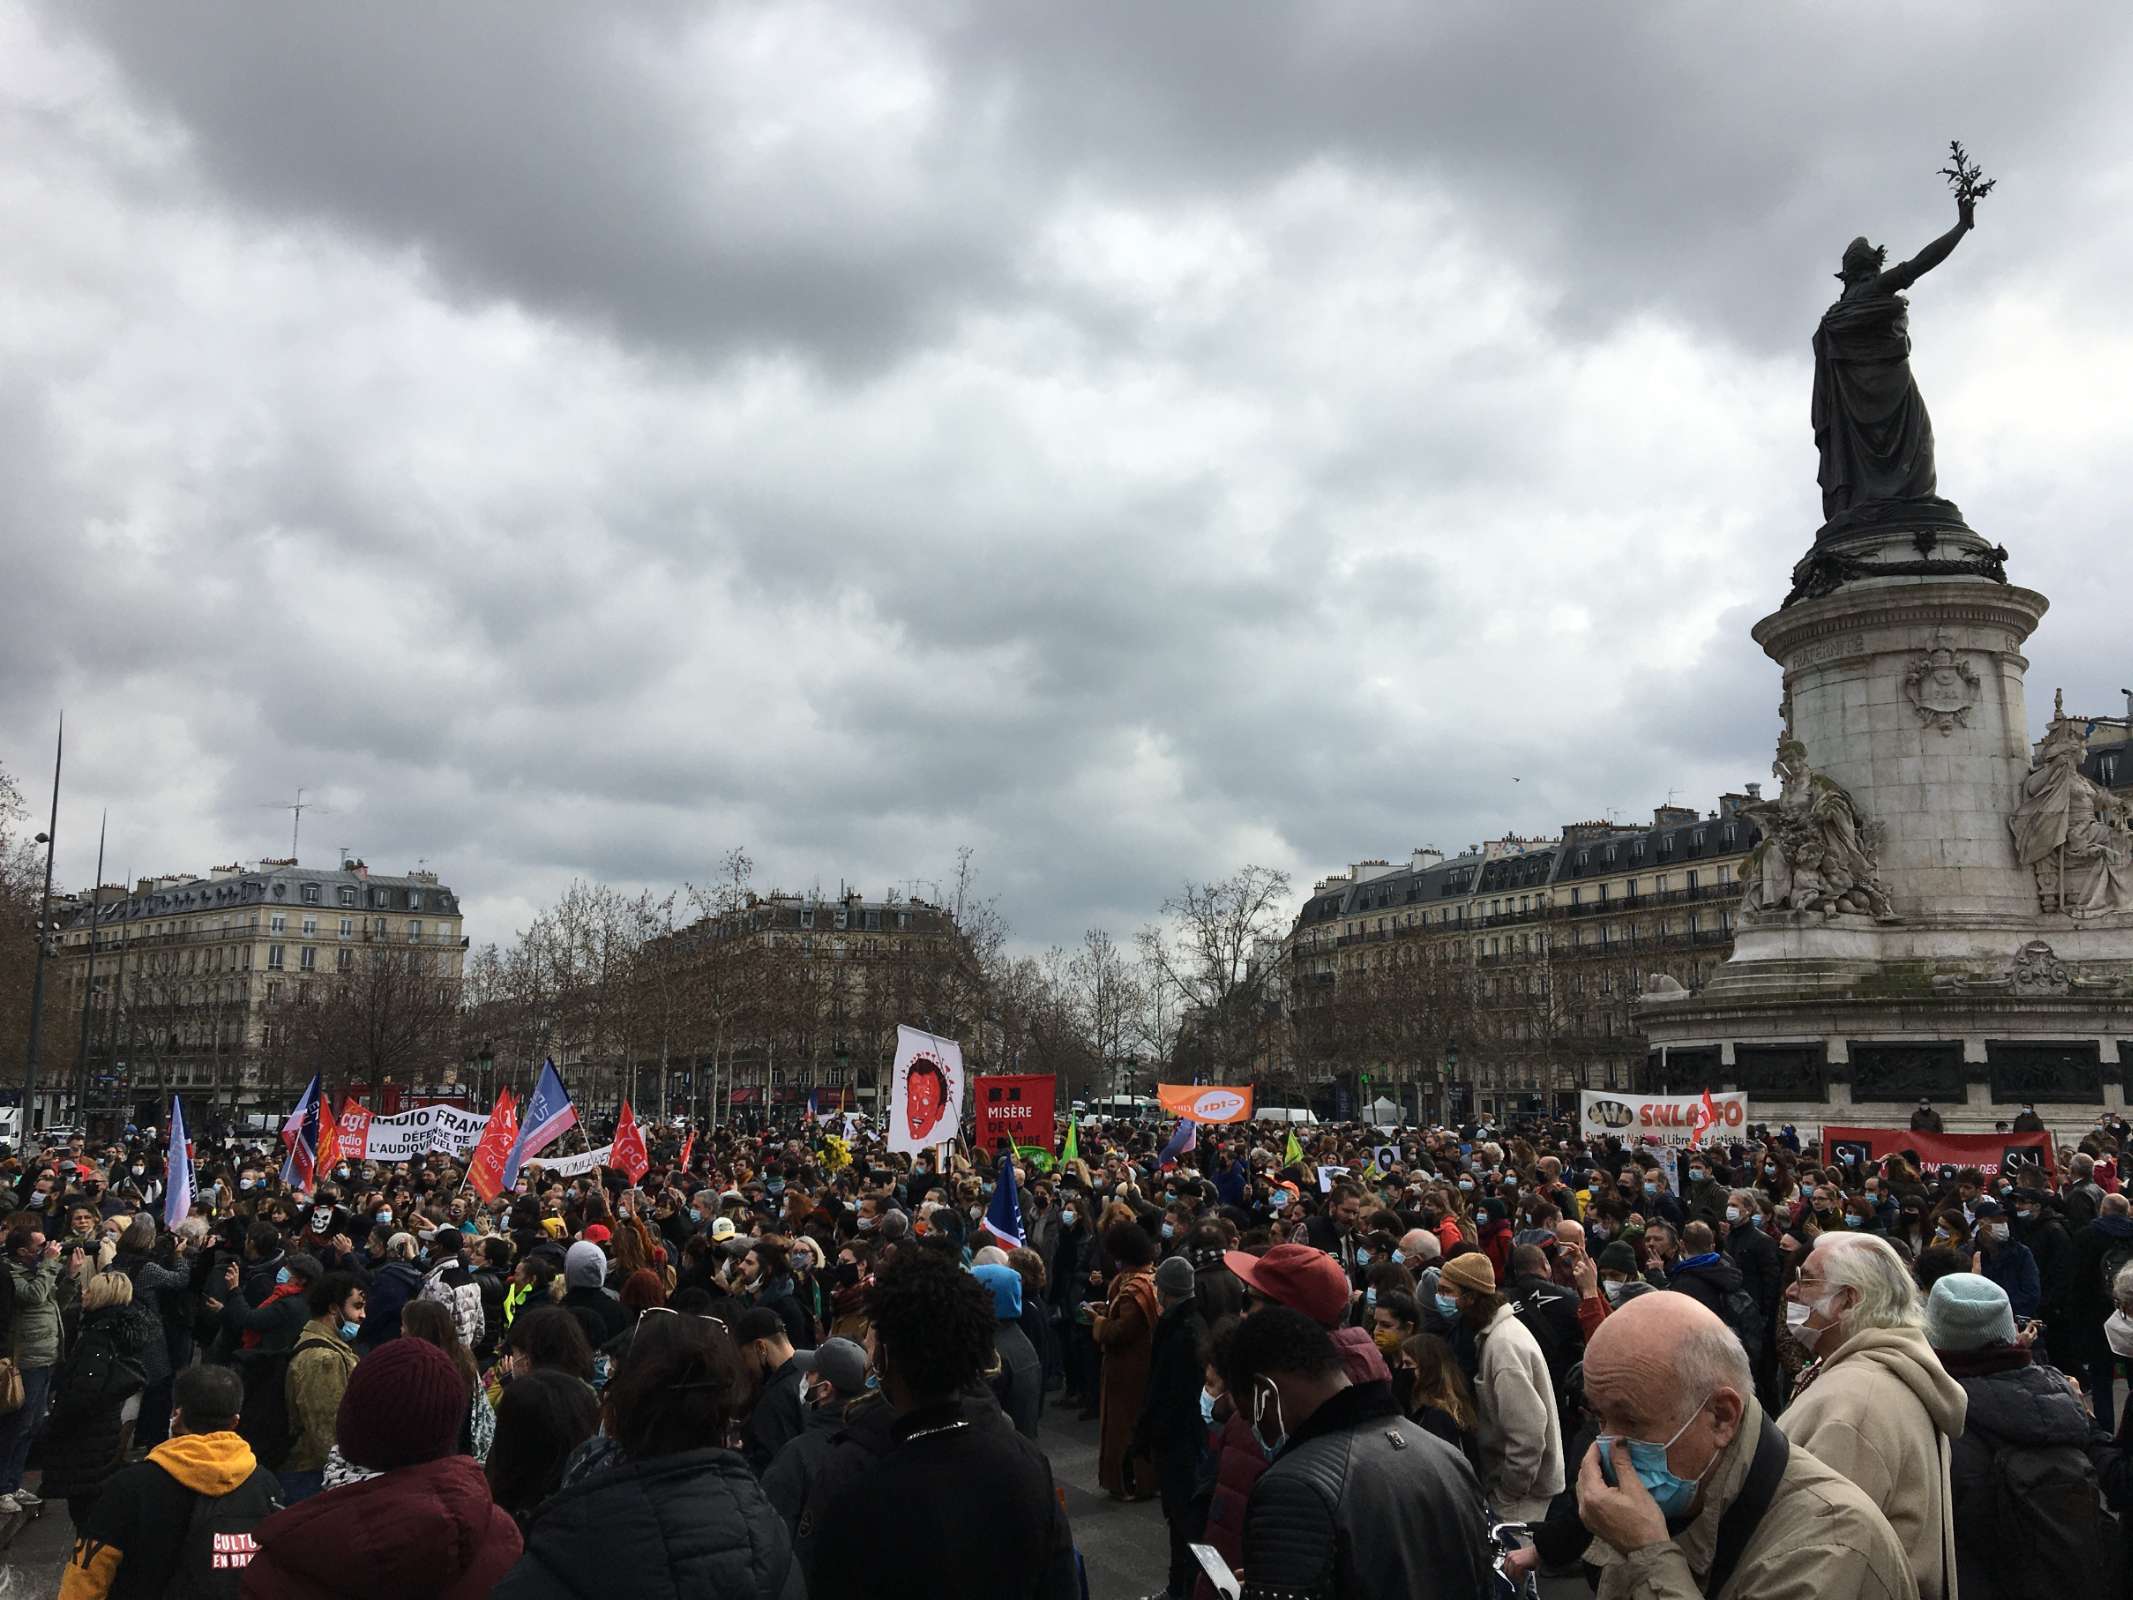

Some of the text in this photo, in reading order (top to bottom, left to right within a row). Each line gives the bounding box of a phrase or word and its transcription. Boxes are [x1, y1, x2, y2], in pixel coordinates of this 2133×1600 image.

[988, 1103, 1032, 1118] MISÈRE
[988, 1121, 1005, 1133] DE
[338, 1133, 362, 1146] adio
[402, 1126, 471, 1145] DÉFENSE DE
[620, 1145, 648, 1170] PCF
[1979, 1163, 1998, 1175] DES
[212, 1553, 229, 1568] EN
